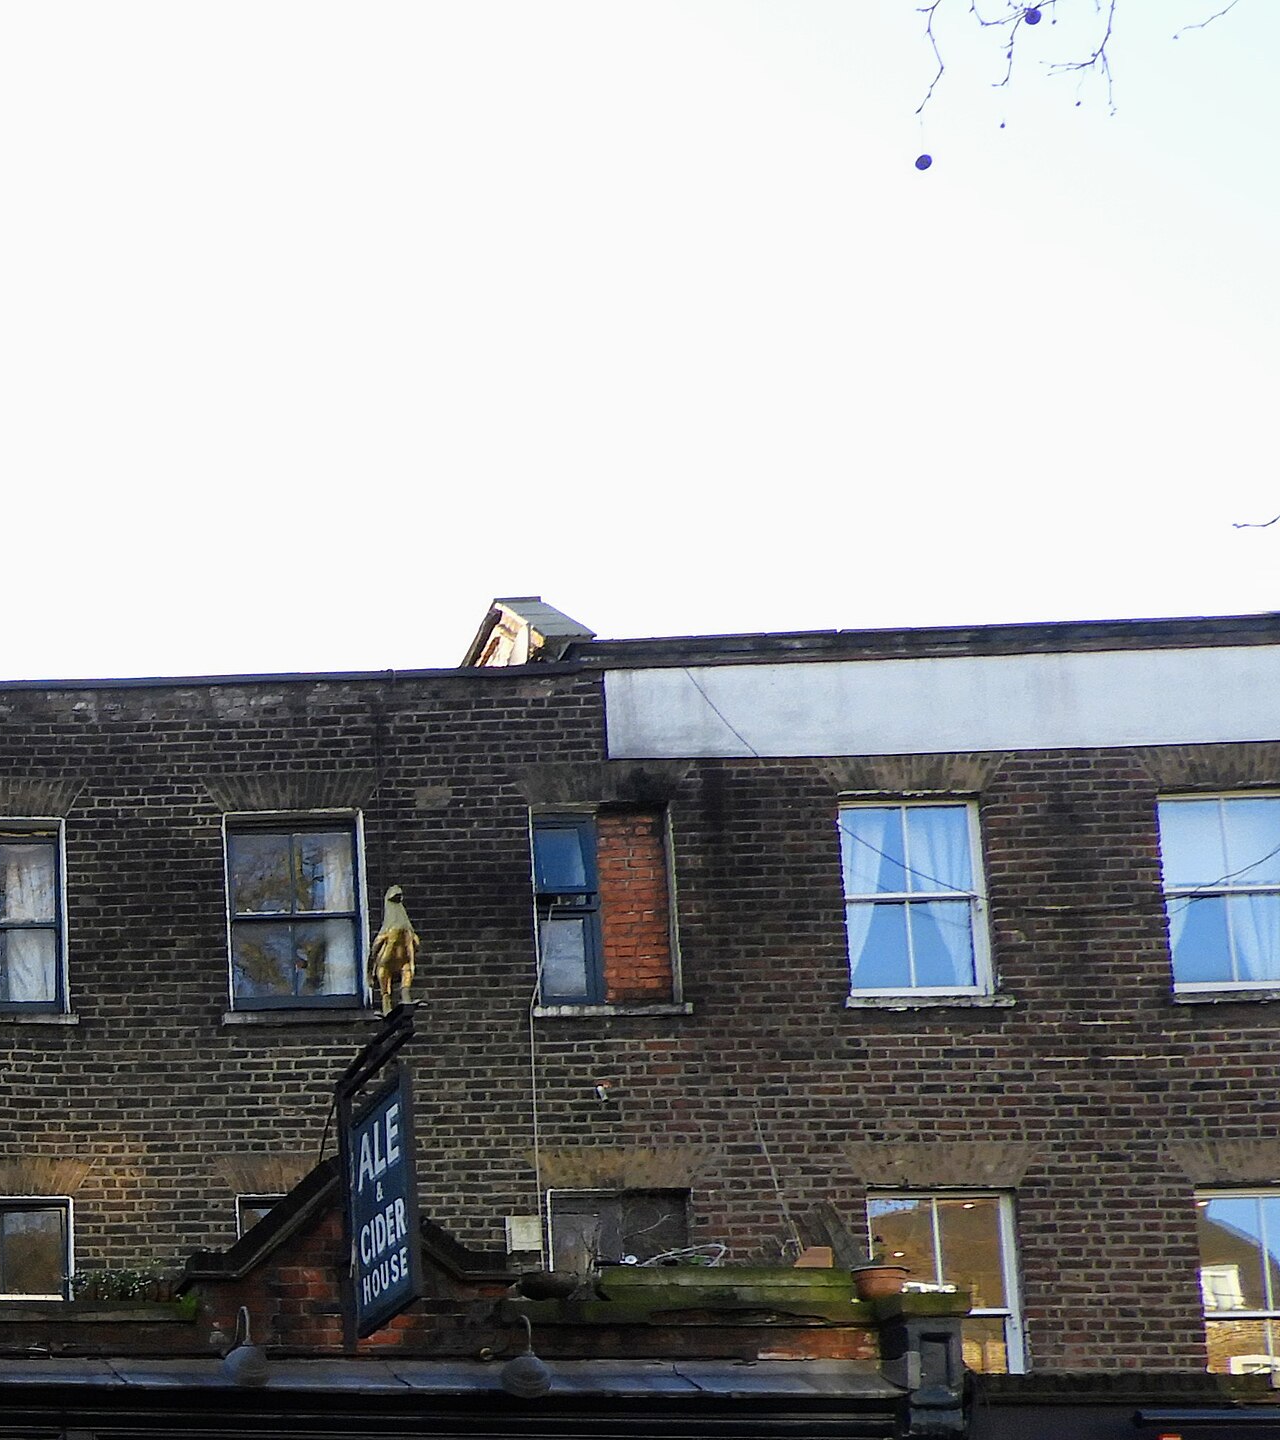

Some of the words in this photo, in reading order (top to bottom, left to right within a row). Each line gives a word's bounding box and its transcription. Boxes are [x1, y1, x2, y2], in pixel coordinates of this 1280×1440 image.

[357, 1103, 401, 1193] ALE
[375, 1181, 385, 1203] &
[359, 1197, 408, 1267] CIDER
[361, 1245, 409, 1306] HOUSE
